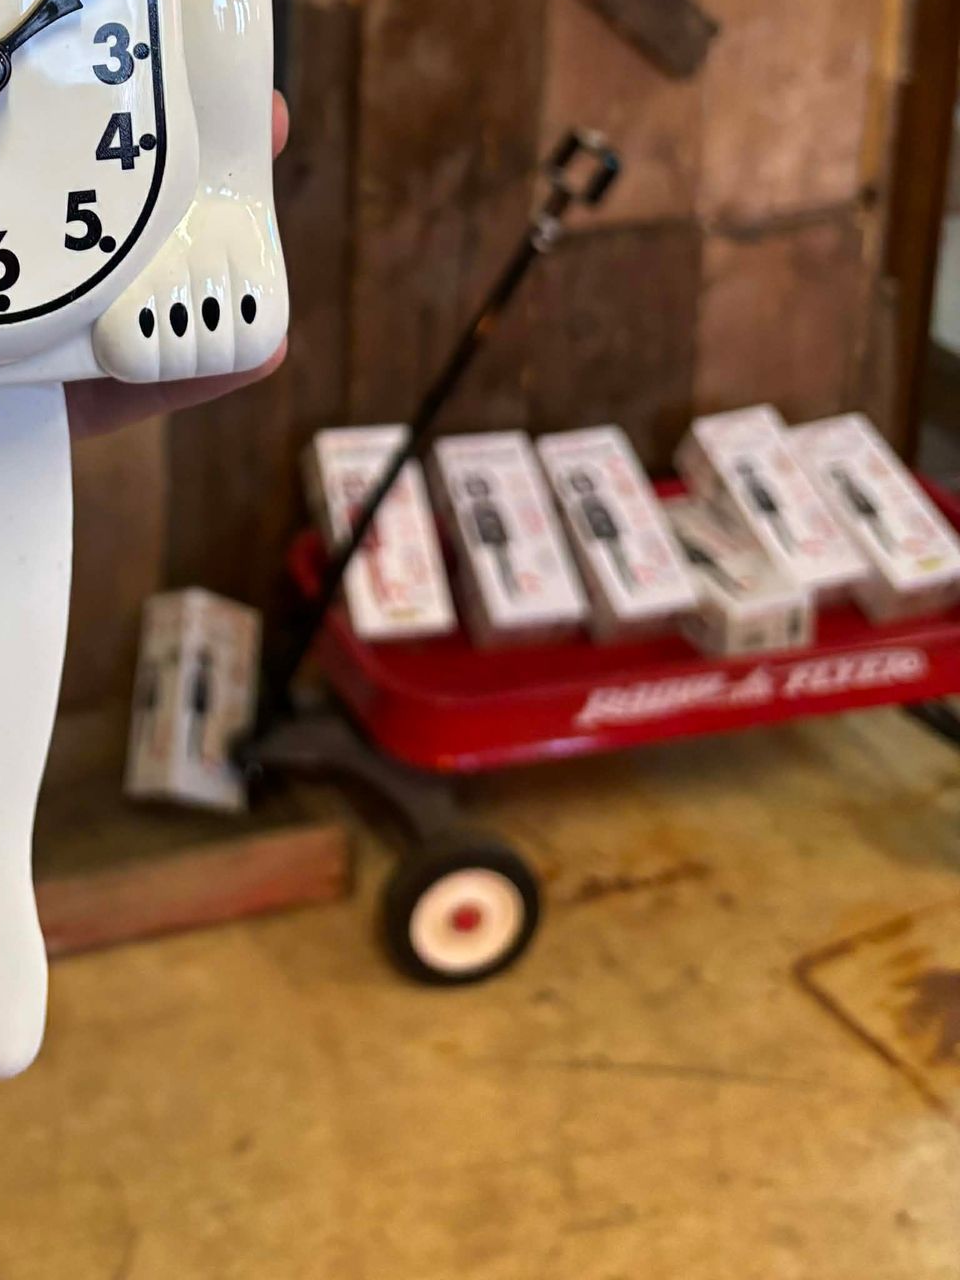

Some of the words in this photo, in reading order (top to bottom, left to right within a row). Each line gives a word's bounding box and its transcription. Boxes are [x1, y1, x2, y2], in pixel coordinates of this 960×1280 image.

[92, 22, 135, 86] 3
[95, 111, 141, 171] 4
[64, 189, 103, 252] 5
